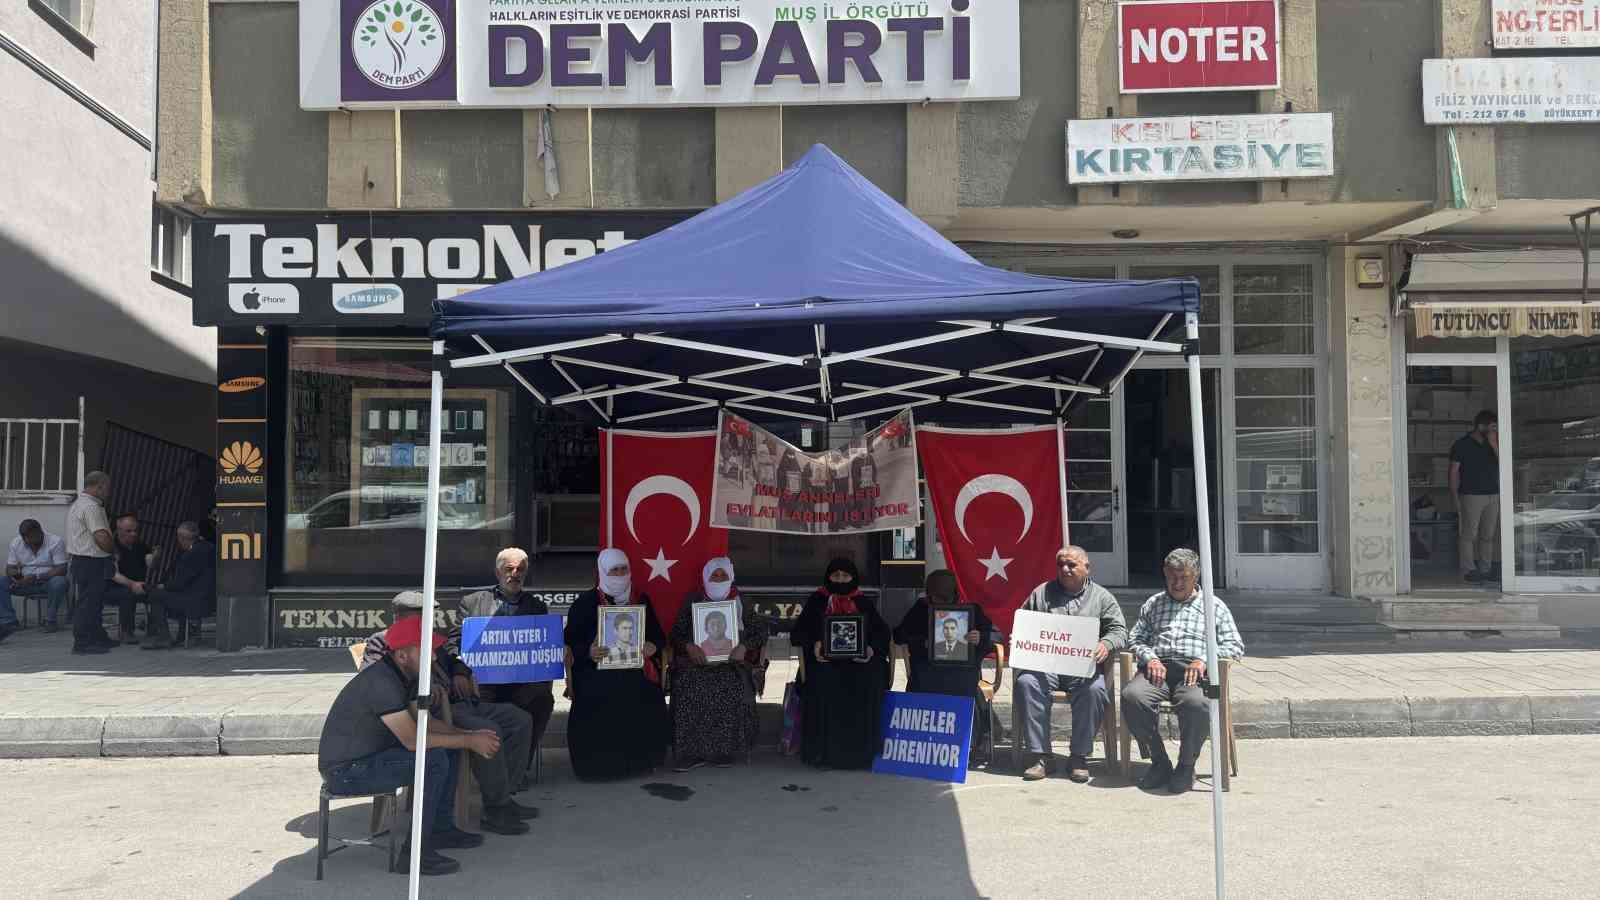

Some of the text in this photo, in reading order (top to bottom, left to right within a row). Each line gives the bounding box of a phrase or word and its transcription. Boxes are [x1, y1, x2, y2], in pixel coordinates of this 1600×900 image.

[490, 6, 740, 22] HALKLARIN EŞİTLİK VE DEMOKRASİ PARTİSİ
[775, 2, 929, 22] MUŞ İL ÖRGÜTÜ
[488, 0, 971, 87] DEM PARTİ
[1130, 26, 1269, 64] NOTER
[372, 70, 393, 84] DEM
[1435, 93, 1466, 107] FİLİZ
[1471, 94, 1542, 106] YAYINCILIK
[1443, 110, 1462, 119] Tel
[1472, 110, 1492, 119] 212
[1496, 110, 1509, 119] 67
[1076, 141, 1328, 176] KIRTASİYE
[1433, 309, 1511, 331] TÜTÜNCÜ
[1528, 309, 1579, 330] NİMET
[219, 475, 263, 485] HUAWEI
[480, 628, 548, 645] ARTIK YETER !
[1039, 630, 1073, 643] EVLAT
[462, 644, 564, 668] YAKAMIZDAN DÜŞÜN
[1015, 639, 1092, 659] NÖBETİNDEYİZ
[889, 706, 957, 736] ANNELER
[882, 733, 961, 769] DİRENİYOR
